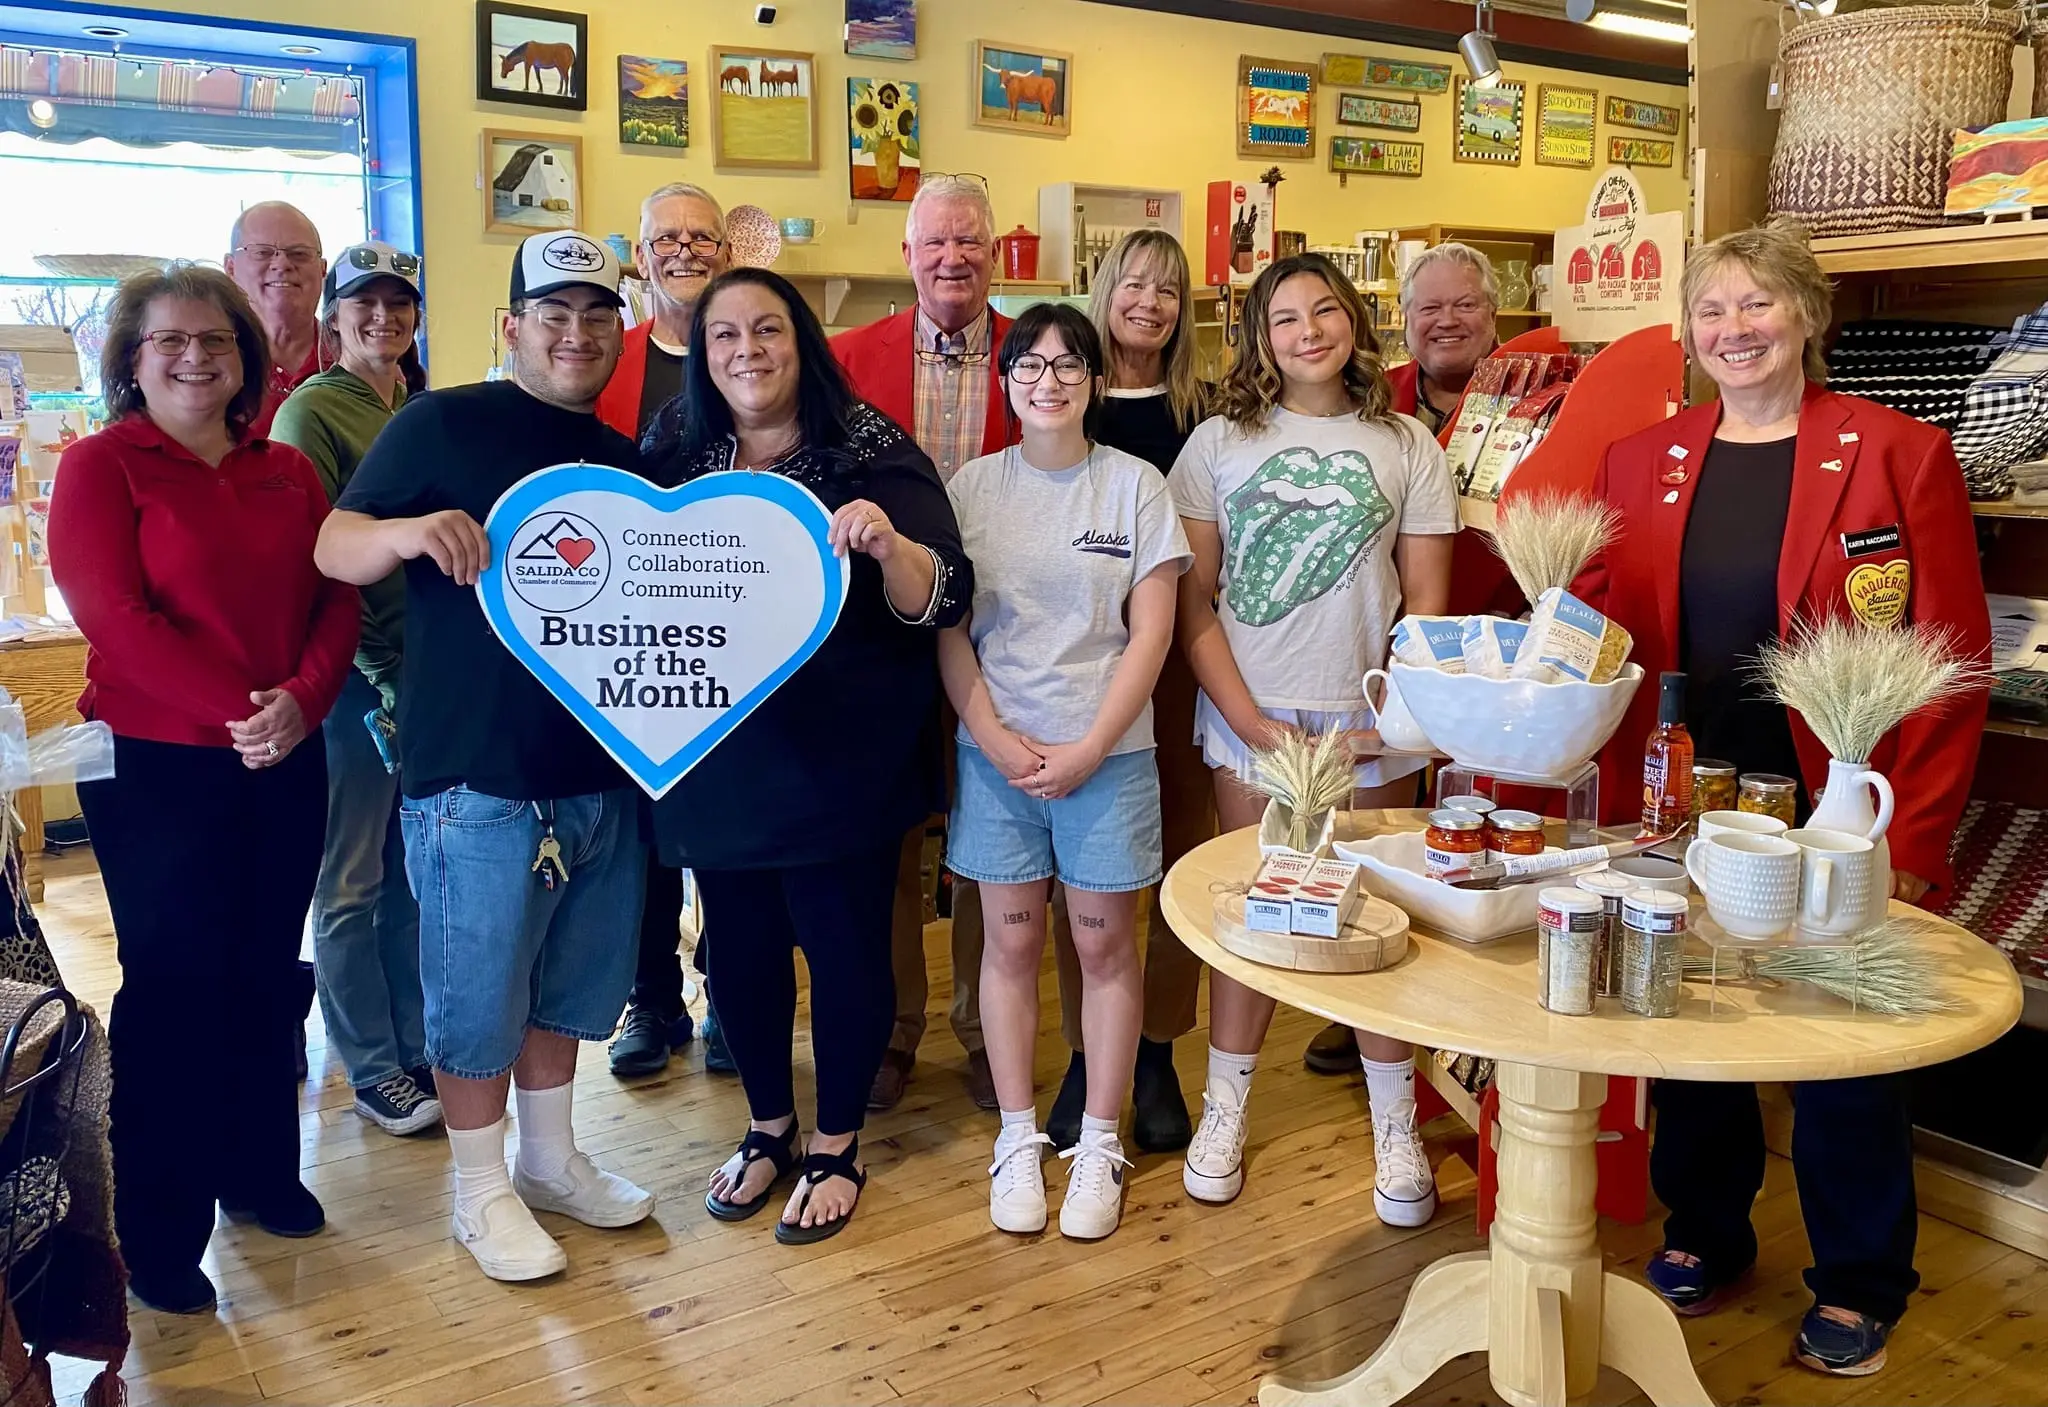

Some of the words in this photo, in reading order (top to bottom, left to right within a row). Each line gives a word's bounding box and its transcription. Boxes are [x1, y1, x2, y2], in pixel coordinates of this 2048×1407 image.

[1259, 127, 1302, 143] RODEO
[1386, 144, 1418, 159] LLAMA
[1543, 141, 1570, 153] SUNNY
[1387, 159, 1412, 171] LOVE
[1638, 256, 1646, 280] 3
[1632, 292, 1644, 302] JUST
[622, 529, 746, 548] Connection.
[1072, 529, 1130, 547] Alaska
[1848, 540, 1865, 548] KARIN
[1866, 533, 1898, 545] NACCARATO
[515, 566, 574, 577] SALIDA
[578, 567, 600, 577] CO
[627, 554, 770, 574] Collaboration.
[518, 578, 550, 586] Chamber
[550, 578, 559, 586] of
[559, 578, 597, 586] Commerce
[1854, 577, 1907, 600] VAQUEROS
[621, 580, 747, 603] Community.
[1866, 591, 1900, 606] Salida
[1560, 603, 1603, 627] DELALLO
[540, 615, 727, 648] Business
[613, 650, 646, 676] of
[654, 650, 707, 676] the
[596, 677, 731, 709] Month
[1003, 911, 1031, 925] 1983
[1078, 914, 1105, 928] 1984
